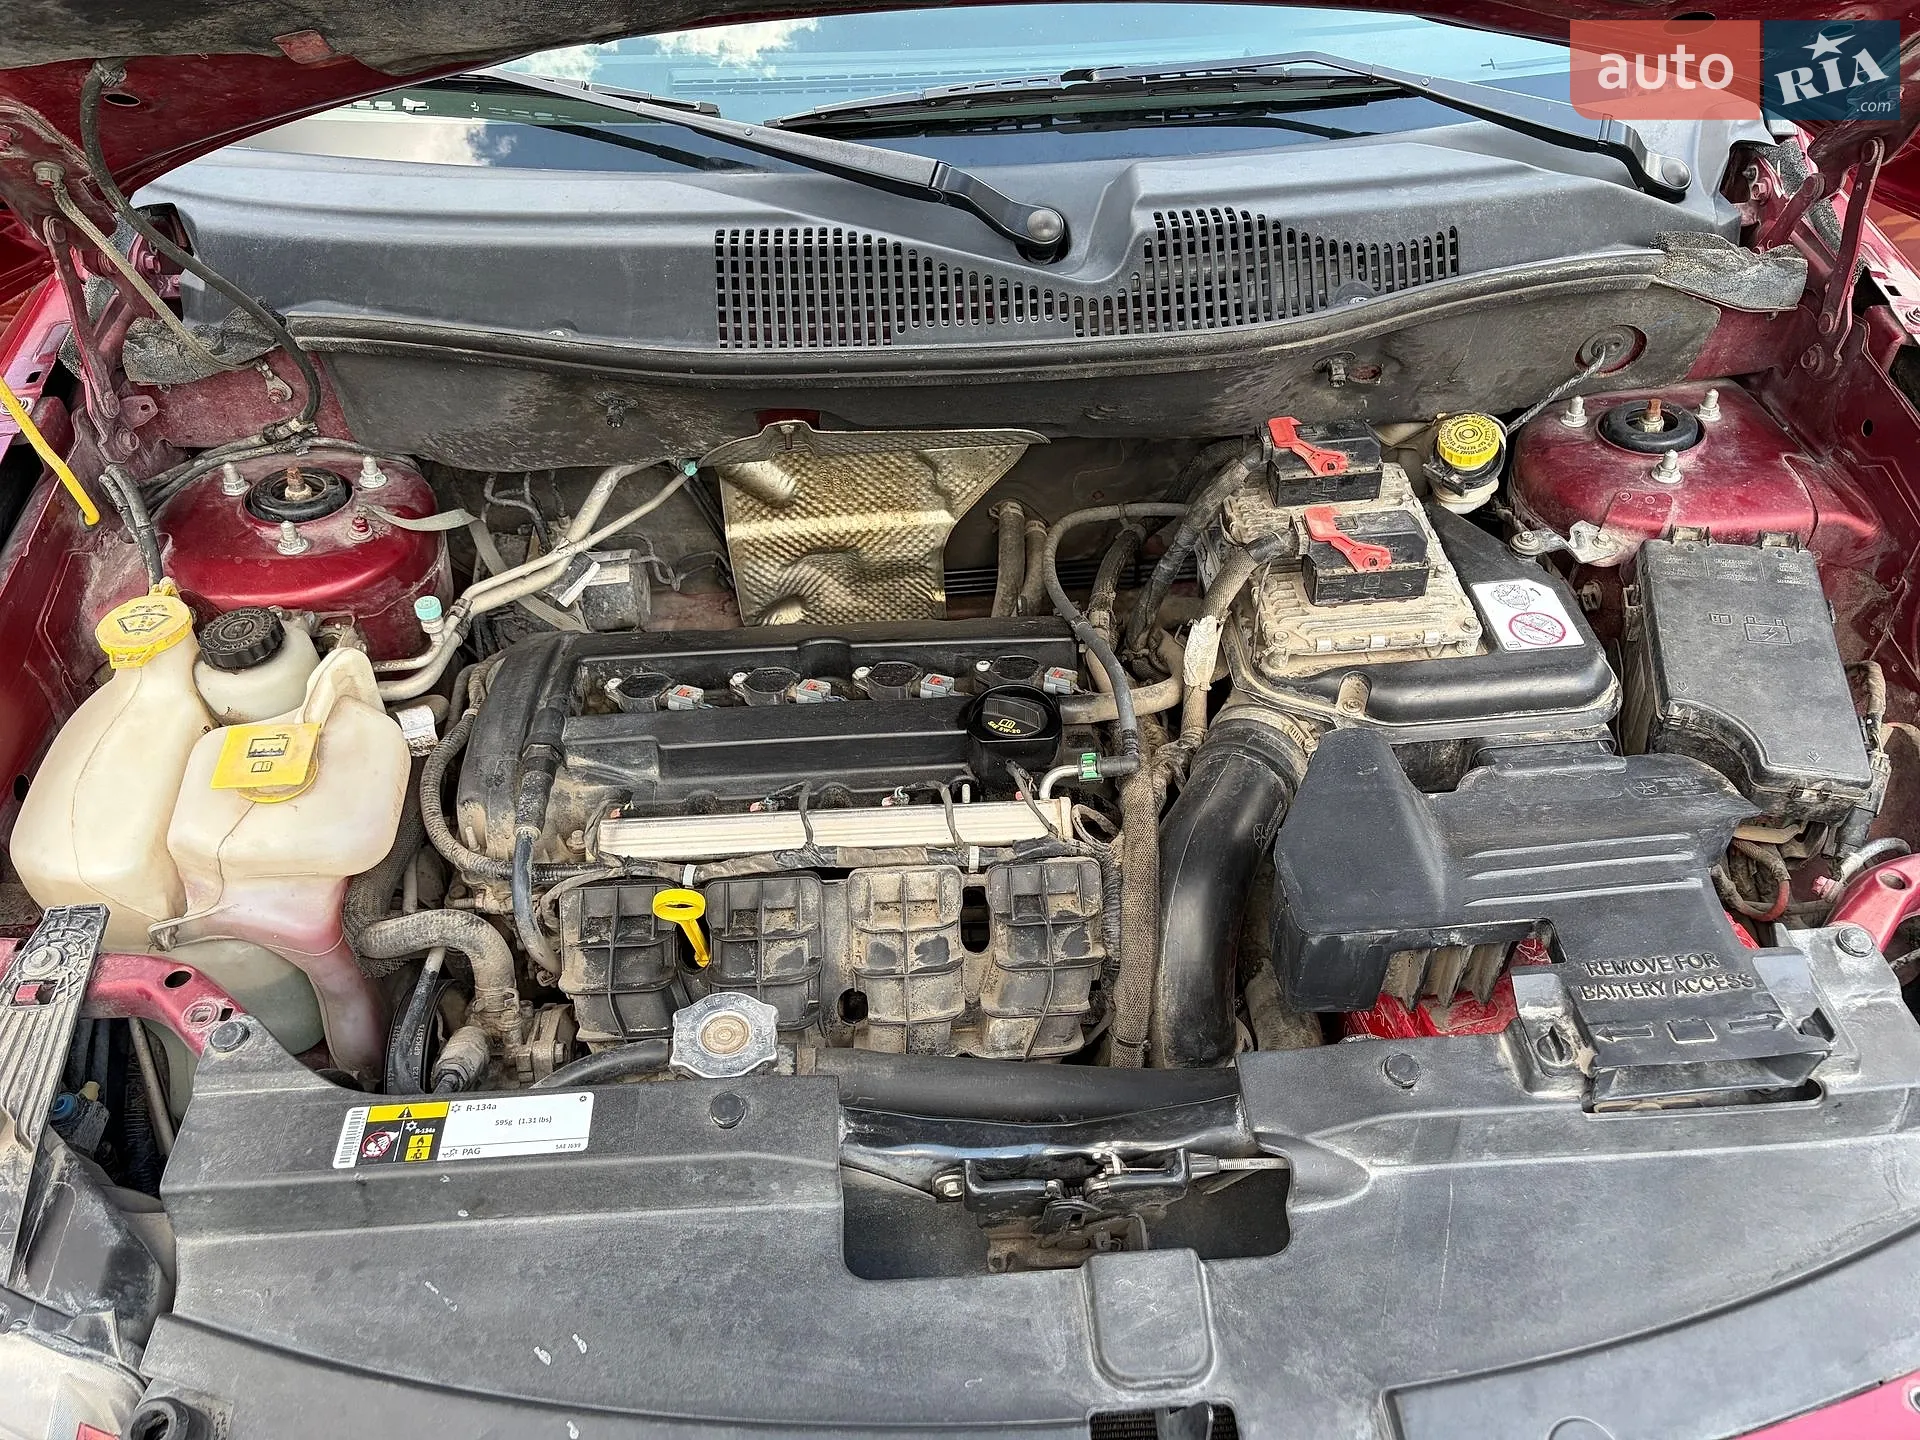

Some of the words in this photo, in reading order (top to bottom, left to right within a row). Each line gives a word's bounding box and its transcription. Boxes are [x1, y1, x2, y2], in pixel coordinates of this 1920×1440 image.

[988, 721, 1000, 730] SAE
[1584, 955, 1674, 977] REMOVE
[1674, 951, 1721, 972] FOR
[1579, 979, 1667, 1001] BATTERY
[1672, 972, 1756, 995] ACCESS
[465, 1102, 497, 1112] R-134a
[495, 1118, 513, 1127] 595g
[518, 1116, 537, 1126] (1.31
[538, 1115, 553, 1124] lbs)
[414, 1127, 437, 1135] R-134a
[461, 1147, 481, 1156] PAG
